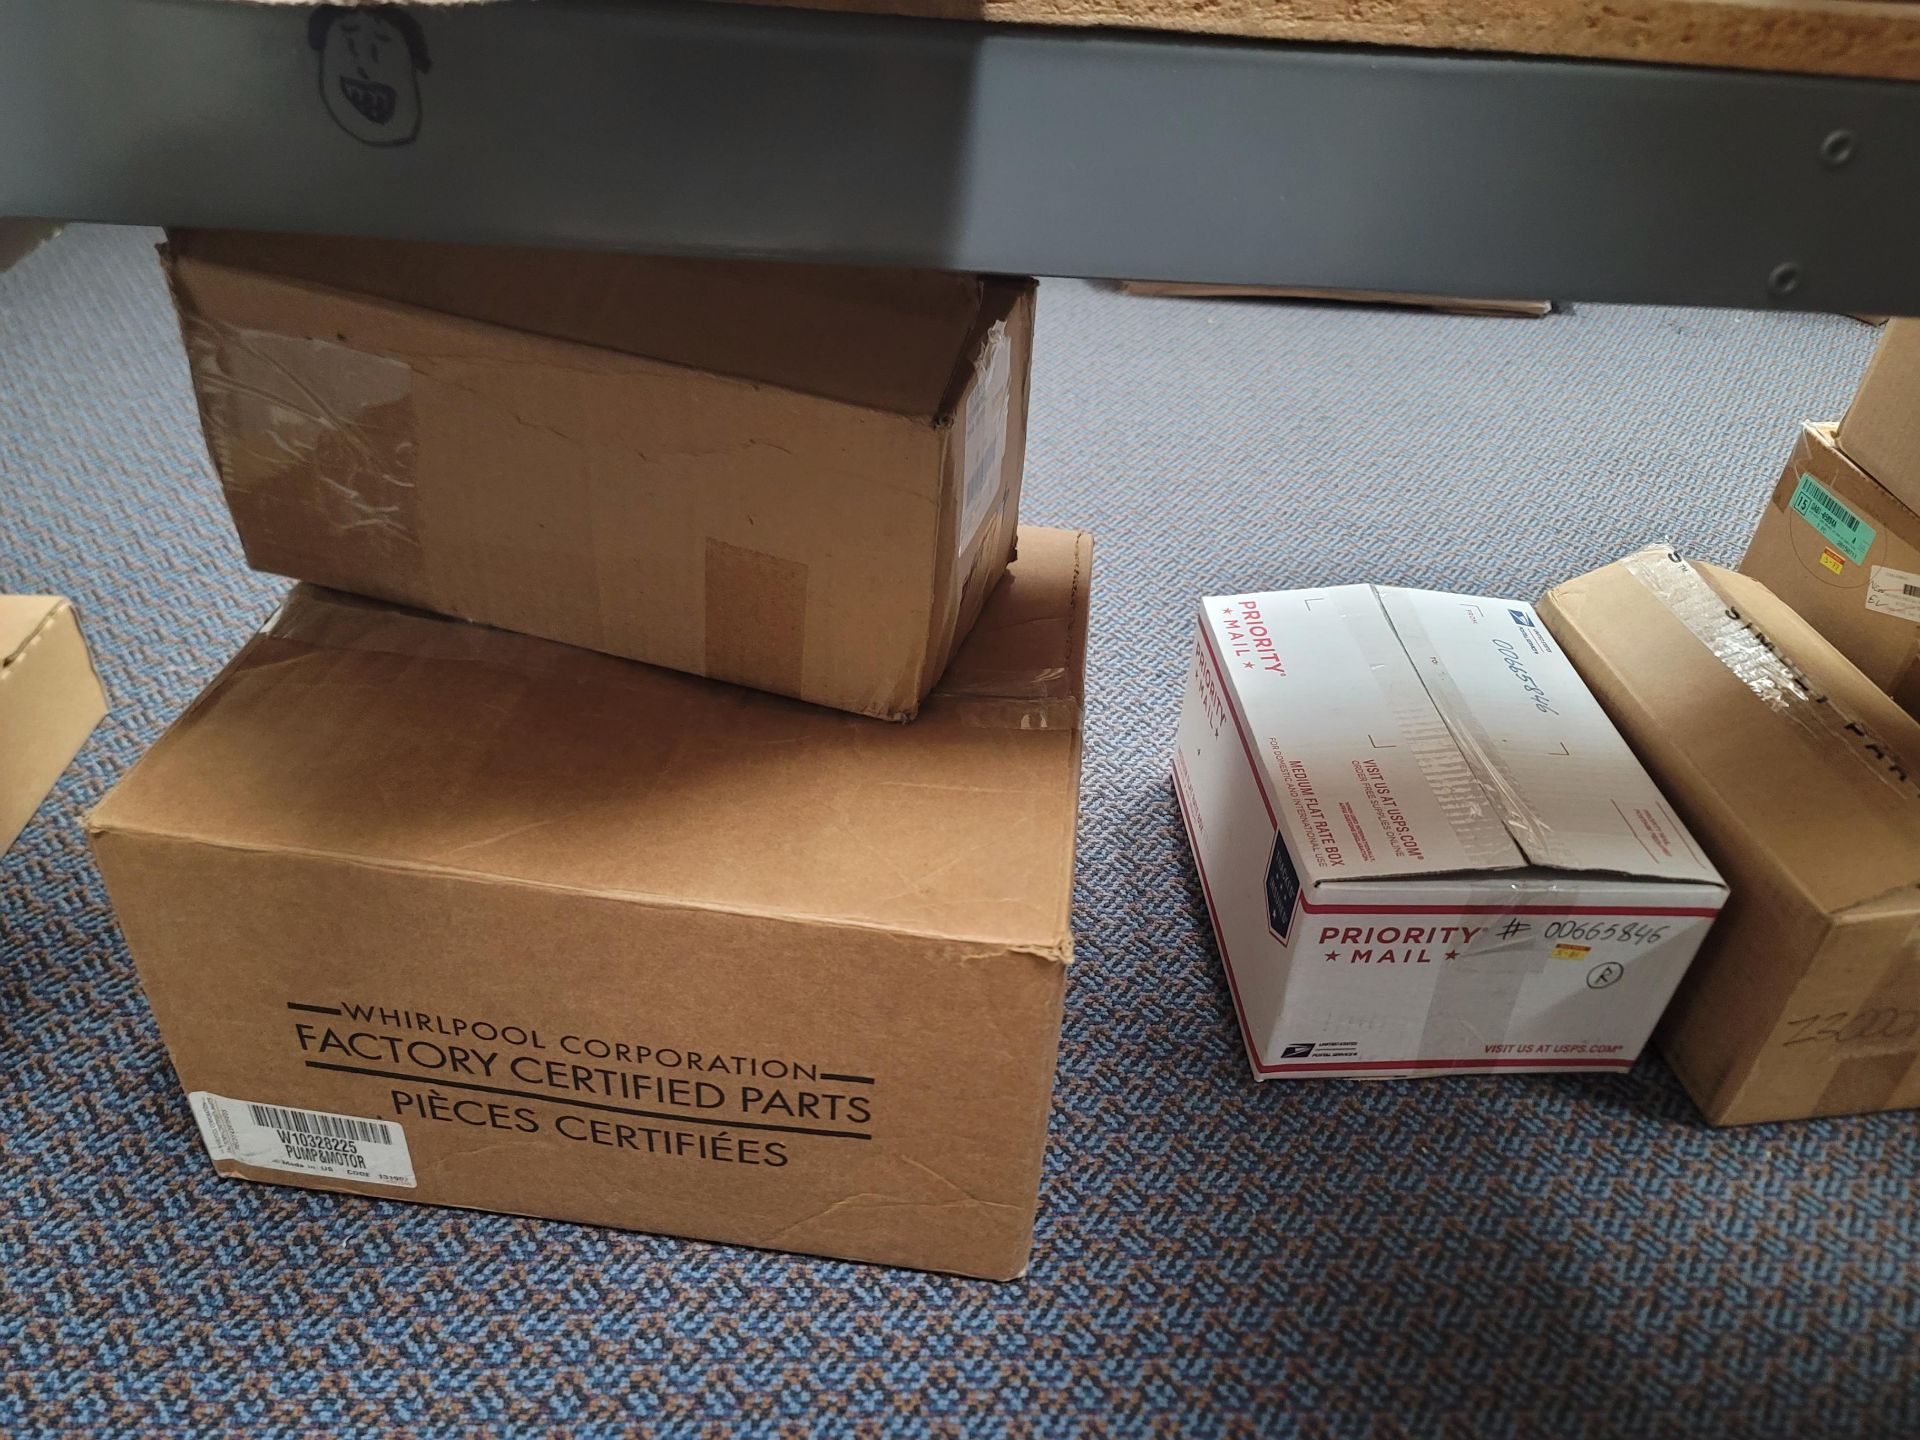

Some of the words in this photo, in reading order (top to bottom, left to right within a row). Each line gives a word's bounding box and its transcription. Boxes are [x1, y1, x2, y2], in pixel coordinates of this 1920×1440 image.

[1797, 496, 1808, 511] 15
[1223, 620, 1251, 657] MAIL
[1199, 681, 1214, 729] MAIL
[1363, 759, 1383, 782] VISIT
[1375, 780, 1390, 795] US
[1268, 736, 1280, 751] FOR
[1274, 750, 1293, 782] DOMESTIC
[1286, 780, 1298, 799] AND
[1293, 798, 1320, 852] INTERNATIONAL
[1315, 851, 1328, 869] USE
[1288, 760, 1315, 797] MEDIUM
[1304, 797, 1324, 821] FLAT
[1314, 820, 1336, 845] RATE
[1325, 843, 1345, 868] BOX
[1351, 760, 1367, 783] ORDER
[1362, 781, 1376, 799] FREE
[1370, 798, 1392, 831] SUPPLIES
[1386, 830, 1405, 858] ONLINE
[1381, 795, 1397, 808] AT
[1544, 920, 1670, 945] 00665846
[1350, 949, 1432, 964] MAIL
[341, 1002, 547, 1049] WHIRLPOOL
[560, 1036, 818, 1081] CORPORATION
[1484, 1044, 1515, 1054] VISIT
[1516, 1044, 1534, 1053] US
[1535, 1044, 1553, 1053] AT
[296, 1023, 498, 1077] FACTORY
[510, 1056, 726, 1109] CERTIFIED
[742, 1087, 872, 1124] PARTS
[391, 1089, 540, 1133] PIÈCES
[555, 1116, 789, 1167] CERTIFIÉES
[276, 1129, 358, 1154] W10328225
[285, 1144, 367, 1169] PUMP&MOTOR
[346, 1169, 371, 1178] CODE
